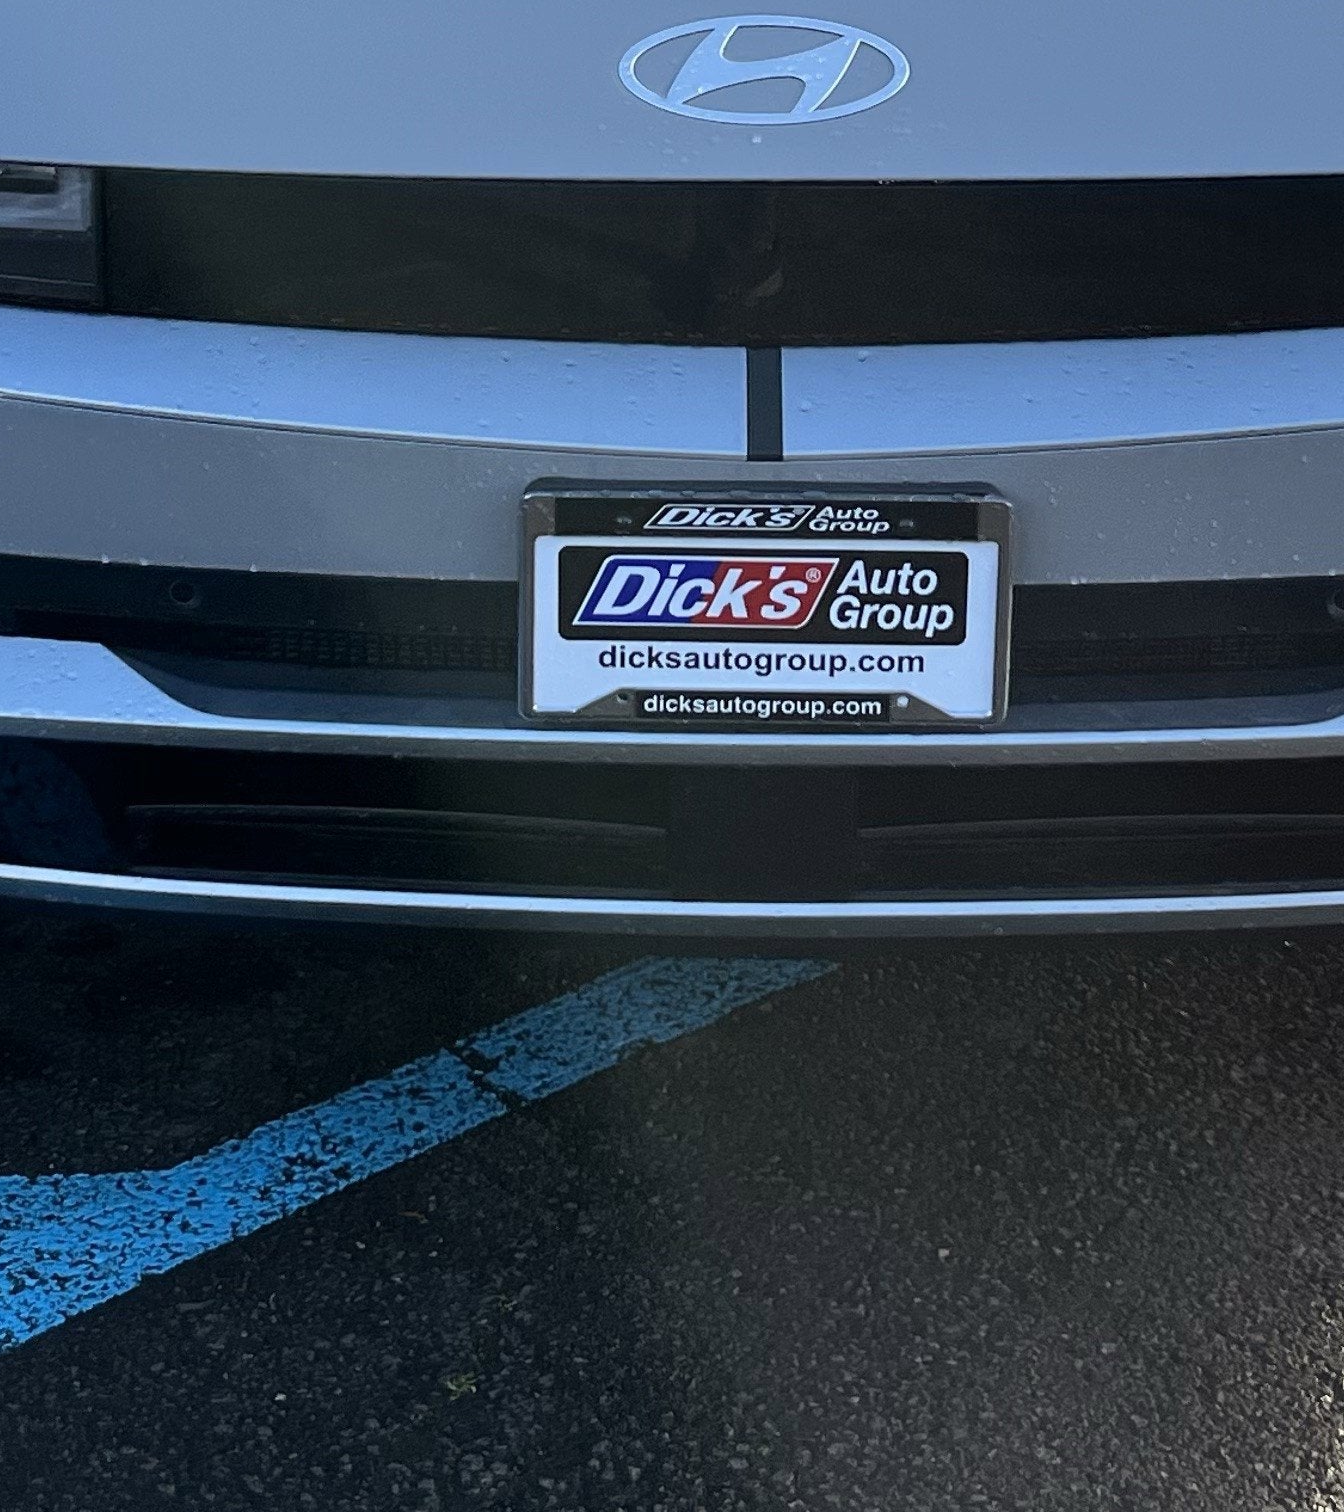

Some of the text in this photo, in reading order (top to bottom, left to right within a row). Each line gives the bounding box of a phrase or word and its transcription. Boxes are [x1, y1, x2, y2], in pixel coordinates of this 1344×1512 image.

[808, 518, 891, 535] Group
[814, 506, 880, 520] Auto
[836, 559, 939, 597] Auto
[829, 594, 955, 638] Group
[598, 645, 926, 676] dicksautogroup.com
[642, 693, 883, 718] dicksautogroup.com
